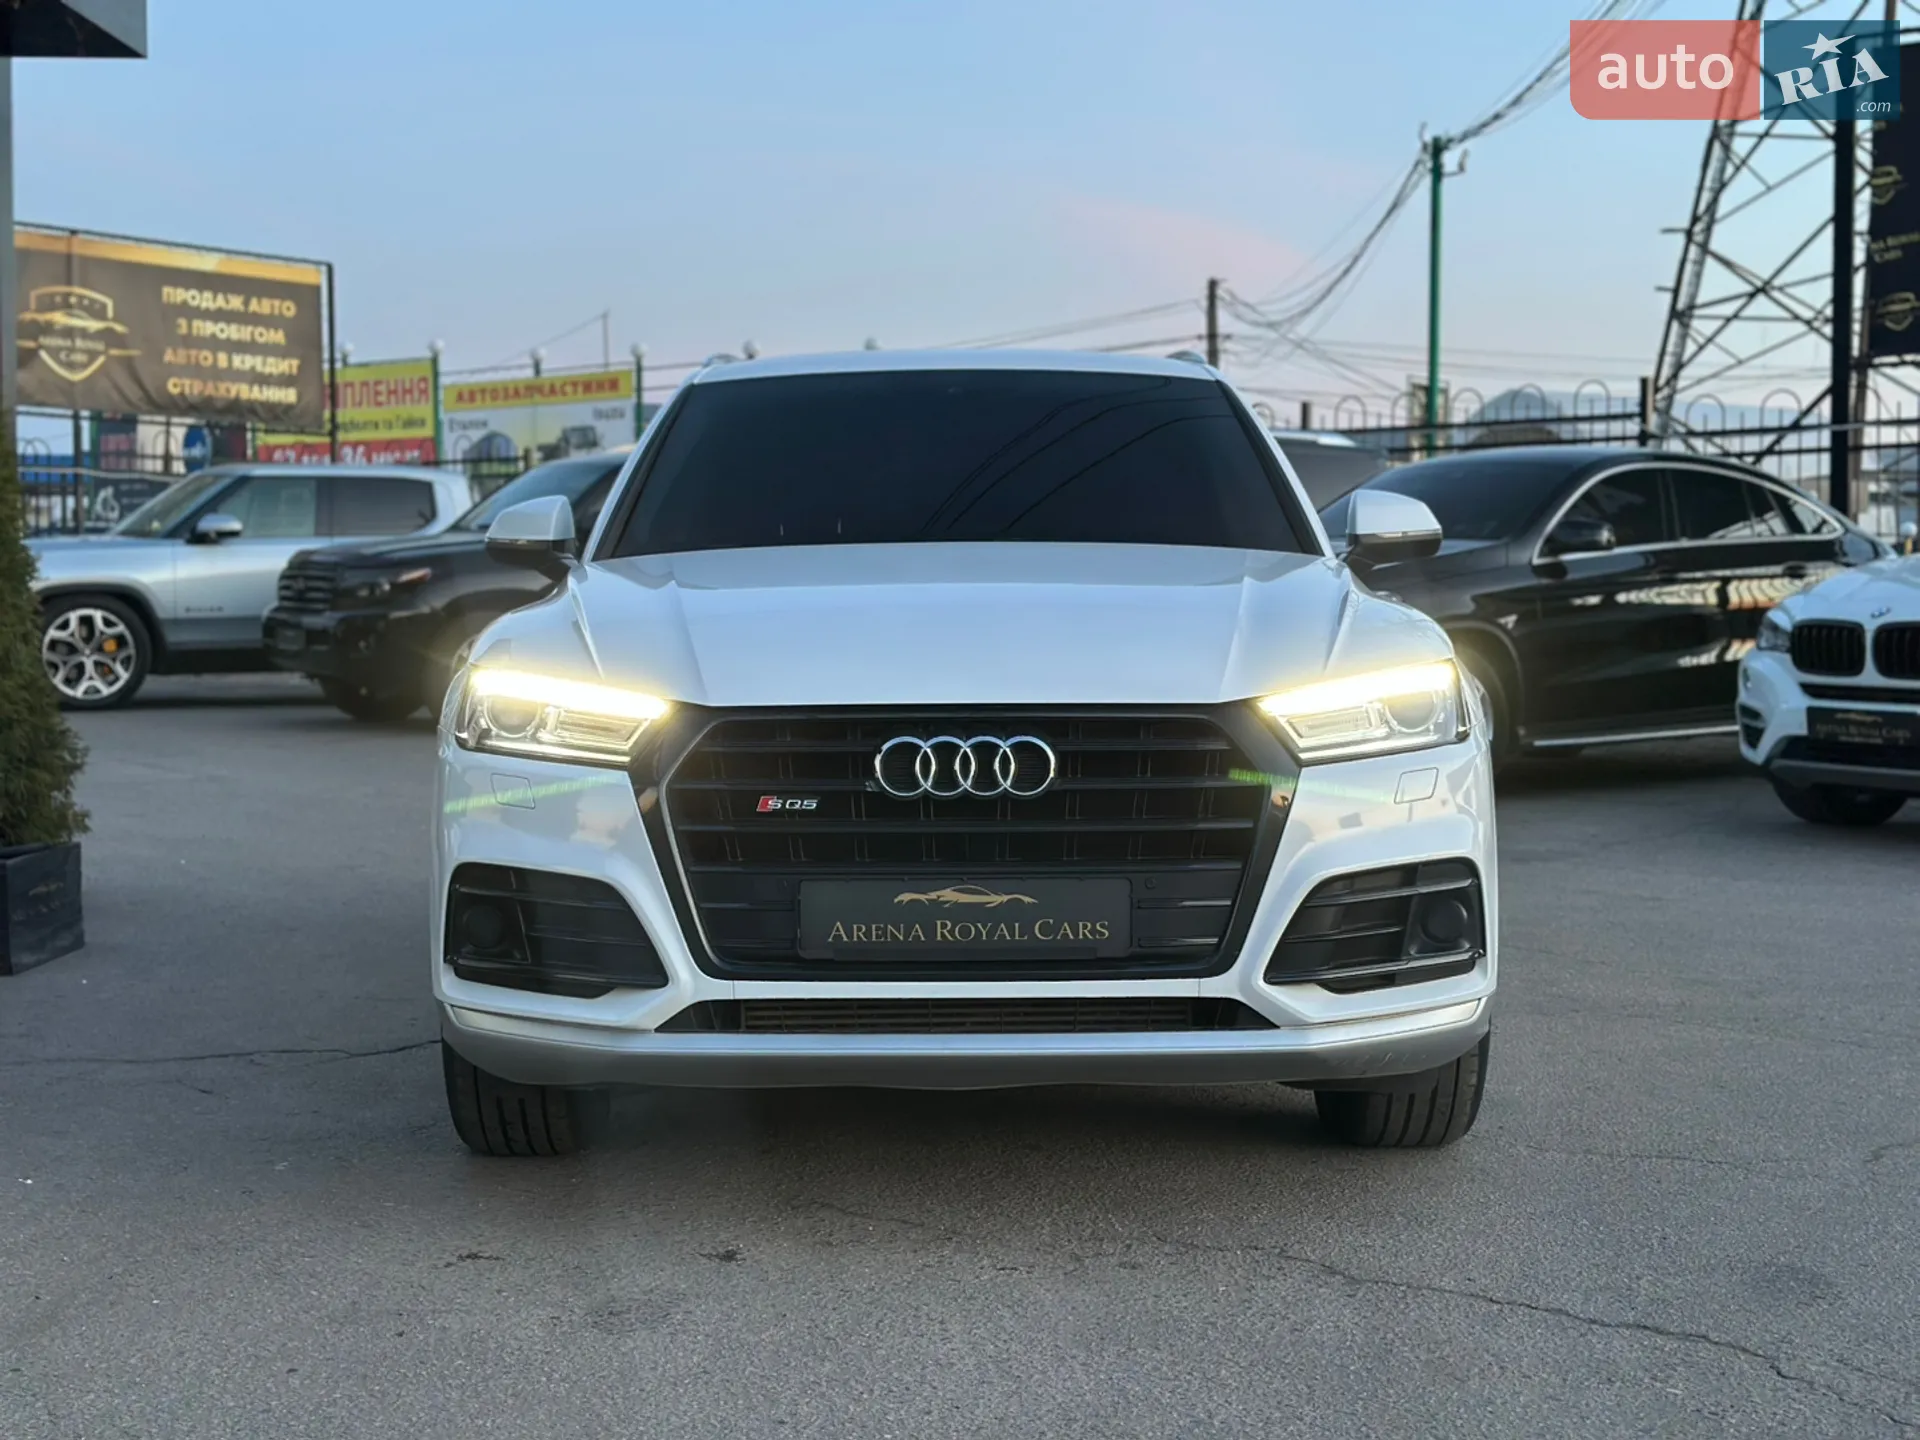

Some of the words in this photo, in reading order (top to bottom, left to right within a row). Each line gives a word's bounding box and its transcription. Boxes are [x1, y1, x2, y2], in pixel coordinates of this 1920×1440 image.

[161, 285, 245, 312] ПРОДАЖ
[248, 296, 297, 318] АВТО
[191, 318, 287, 345] ПРОБІГОМ
[163, 346, 214, 367] АВТО
[216, 351, 229, 369] В
[231, 352, 300, 376] КРЕДИТ
[166, 376, 298, 405] СТРАХУВАННЯ
[455, 376, 621, 405] АВТОЗАПЧАСТИНИ
[756, 795, 819, 812] SQ5
[827, 920, 926, 942] ARENA
[935, 919, 1028, 942] ROYAL
[1034, 918, 1110, 940] CARS
